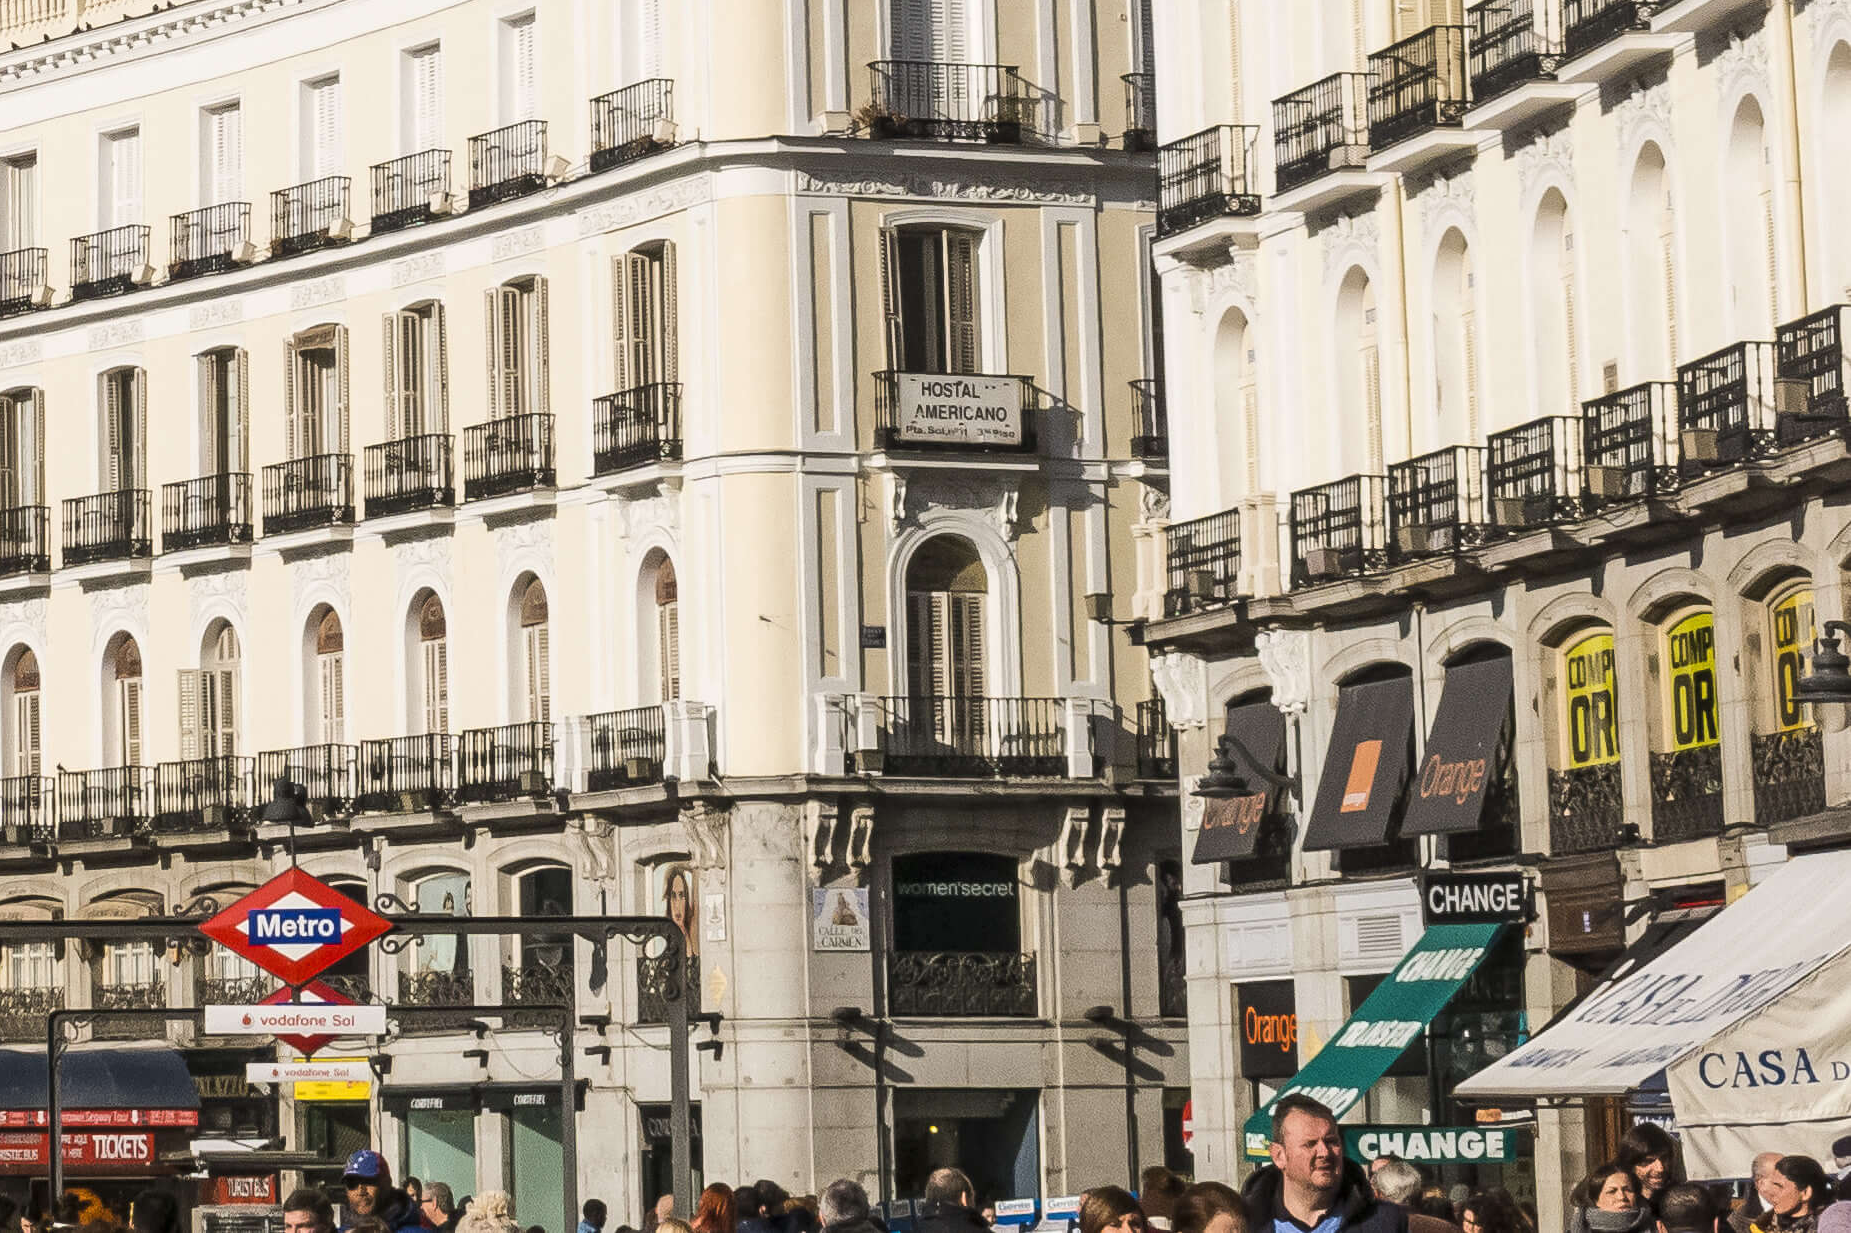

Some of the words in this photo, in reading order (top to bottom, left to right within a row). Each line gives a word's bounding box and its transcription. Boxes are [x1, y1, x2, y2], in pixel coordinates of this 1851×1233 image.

[921, 381, 981, 399] HOSTAL
[915, 403, 1008, 422] AMERICANO
[1670, 625, 1715, 670] COMP
[1568, 649, 1616, 690] COMP
[1672, 667, 1719, 746] OR
[1570, 688, 1620, 764] OR
[1419, 753, 1487, 805] Orange
[898, 881, 1014, 897] women'secret
[1428, 883, 1521, 914] CHANGE
[256, 913, 335, 938] Metro
[818, 926, 846, 936] CALLE
[821, 937, 862, 948] CARMEN
[260, 1014, 327, 1027] vodafone
[332, 1014, 355, 1027] Sol
[1245, 1006, 1298, 1053] Orange
[284, 1068, 330, 1077] vodafone
[1699, 1047, 1821, 1089] CASA
[1832, 1061, 1850, 1081] D
[92, 1134, 149, 1160] TICKETS
[1357, 1131, 1505, 1160] CHANGE
